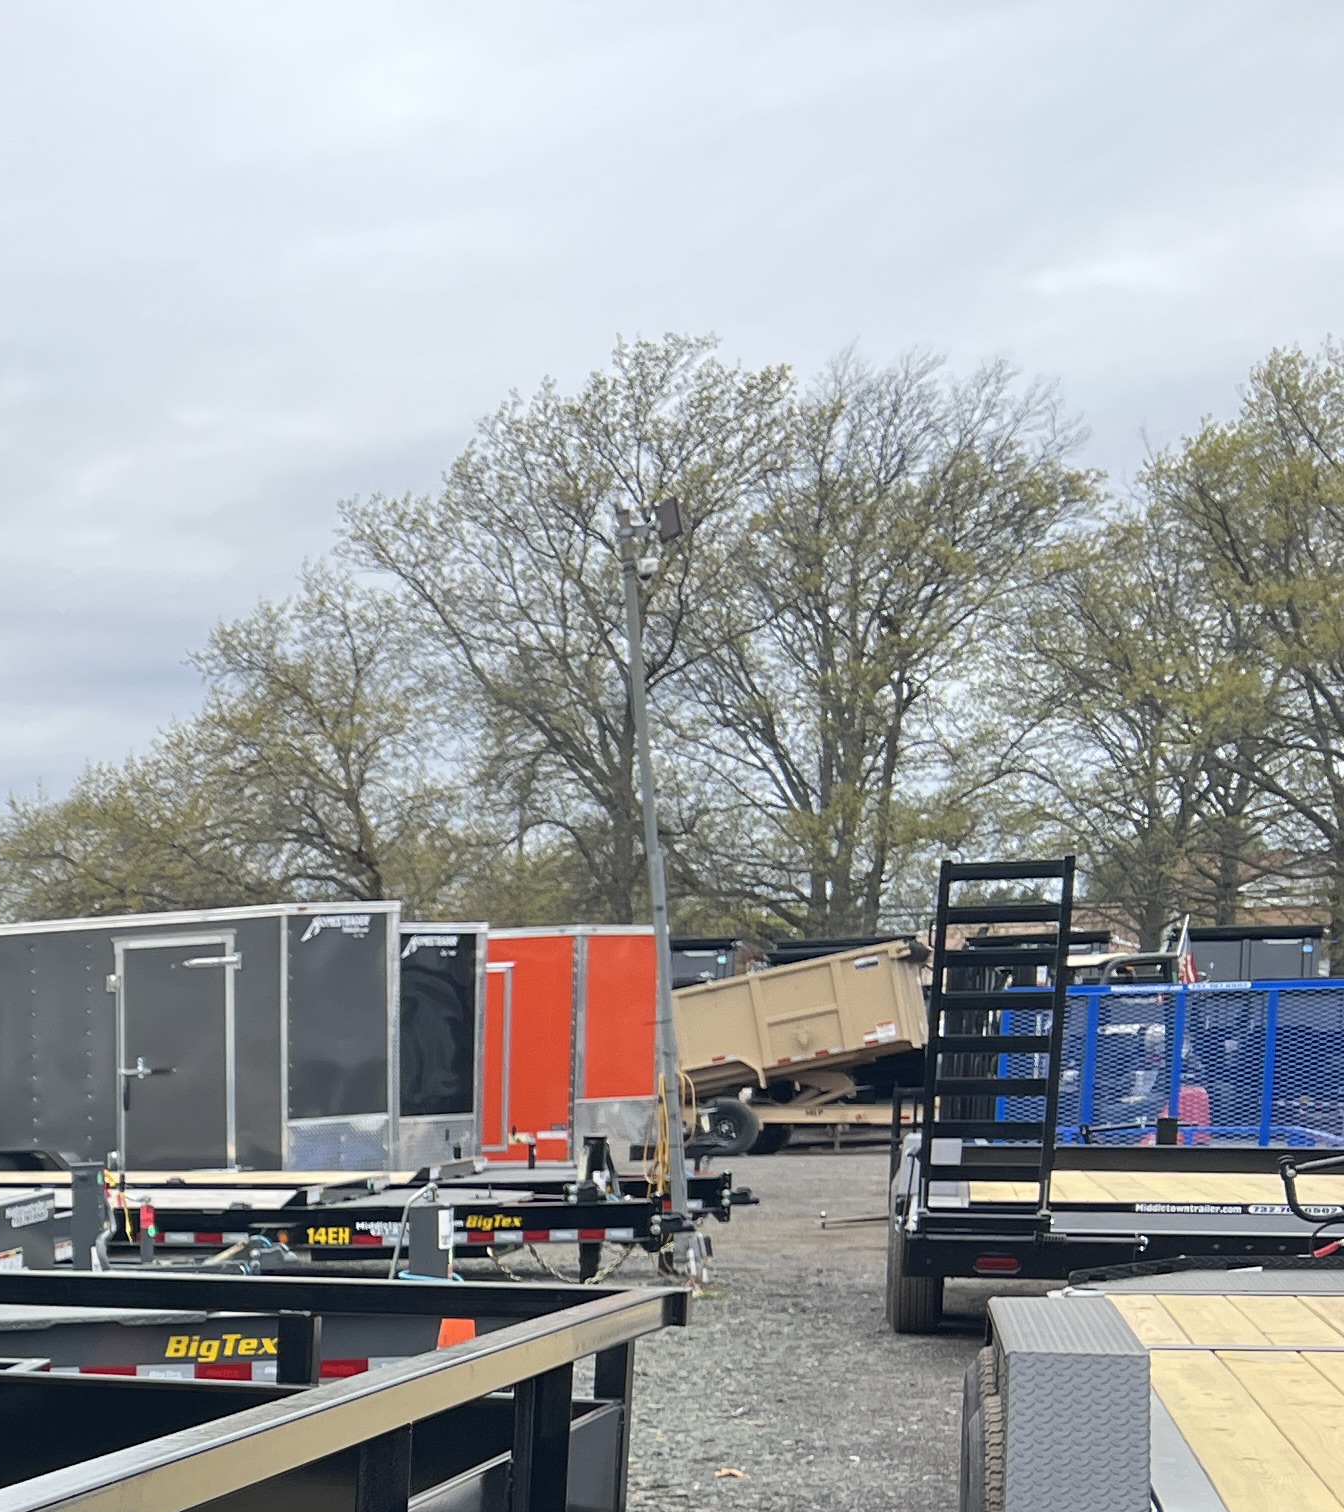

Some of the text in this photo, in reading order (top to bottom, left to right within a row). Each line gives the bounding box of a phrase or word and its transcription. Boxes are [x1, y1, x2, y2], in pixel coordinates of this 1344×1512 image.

[1135, 1203, 1243, 1215] Middletowntrailer.com
[465, 1214, 523, 1231] BigTex
[306, 1227, 350, 1245] 14EH
[165, 1334, 279, 1362] BigTex
